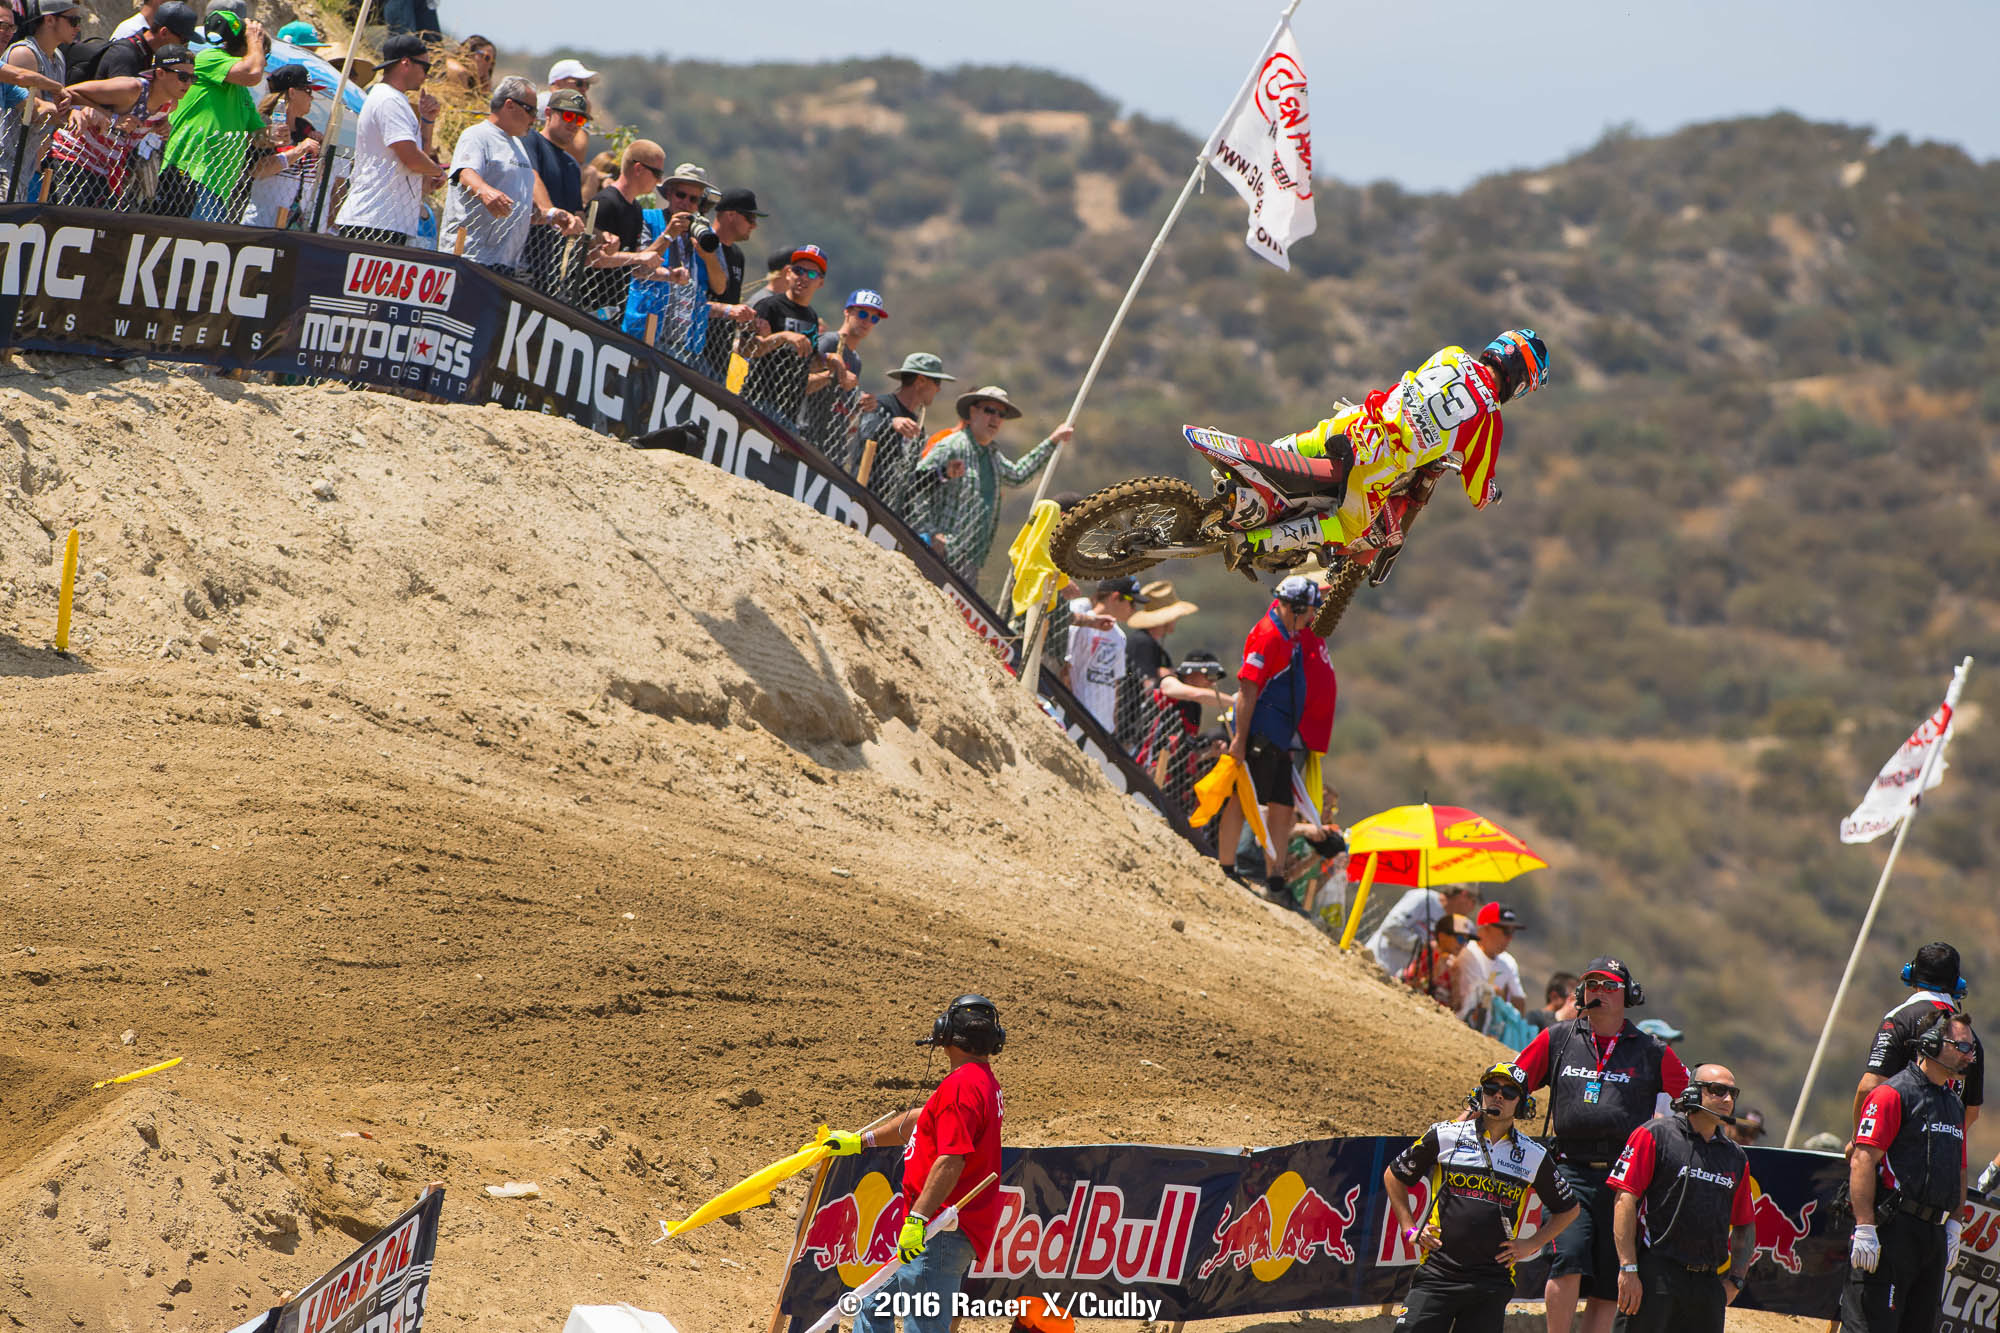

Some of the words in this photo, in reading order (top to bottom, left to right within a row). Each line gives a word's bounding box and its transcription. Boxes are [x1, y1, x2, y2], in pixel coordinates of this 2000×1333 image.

[0, 223, 95, 299] MC
[118, 233, 275, 318] KMC
[348, 258, 418, 300] LUCAS
[419, 268, 452, 305] OIL
[115, 319, 262, 350] WHEELS
[368, 303, 421, 323] PRO
[297, 352, 467, 396] CHAMPIOSHIP
[498, 300, 632, 421] KMC
[1497, 1159, 1531, 1175] Husqvarna
[969, 1179, 1089, 1279] Red
[1072, 1182, 1201, 1285] Bull
[304, 1250, 377, 1333] LUCAS
[376, 1223, 413, 1285] OIL
[1957, 1255, 1997, 1280] RO
[345, 1297, 376, 1332] RO
